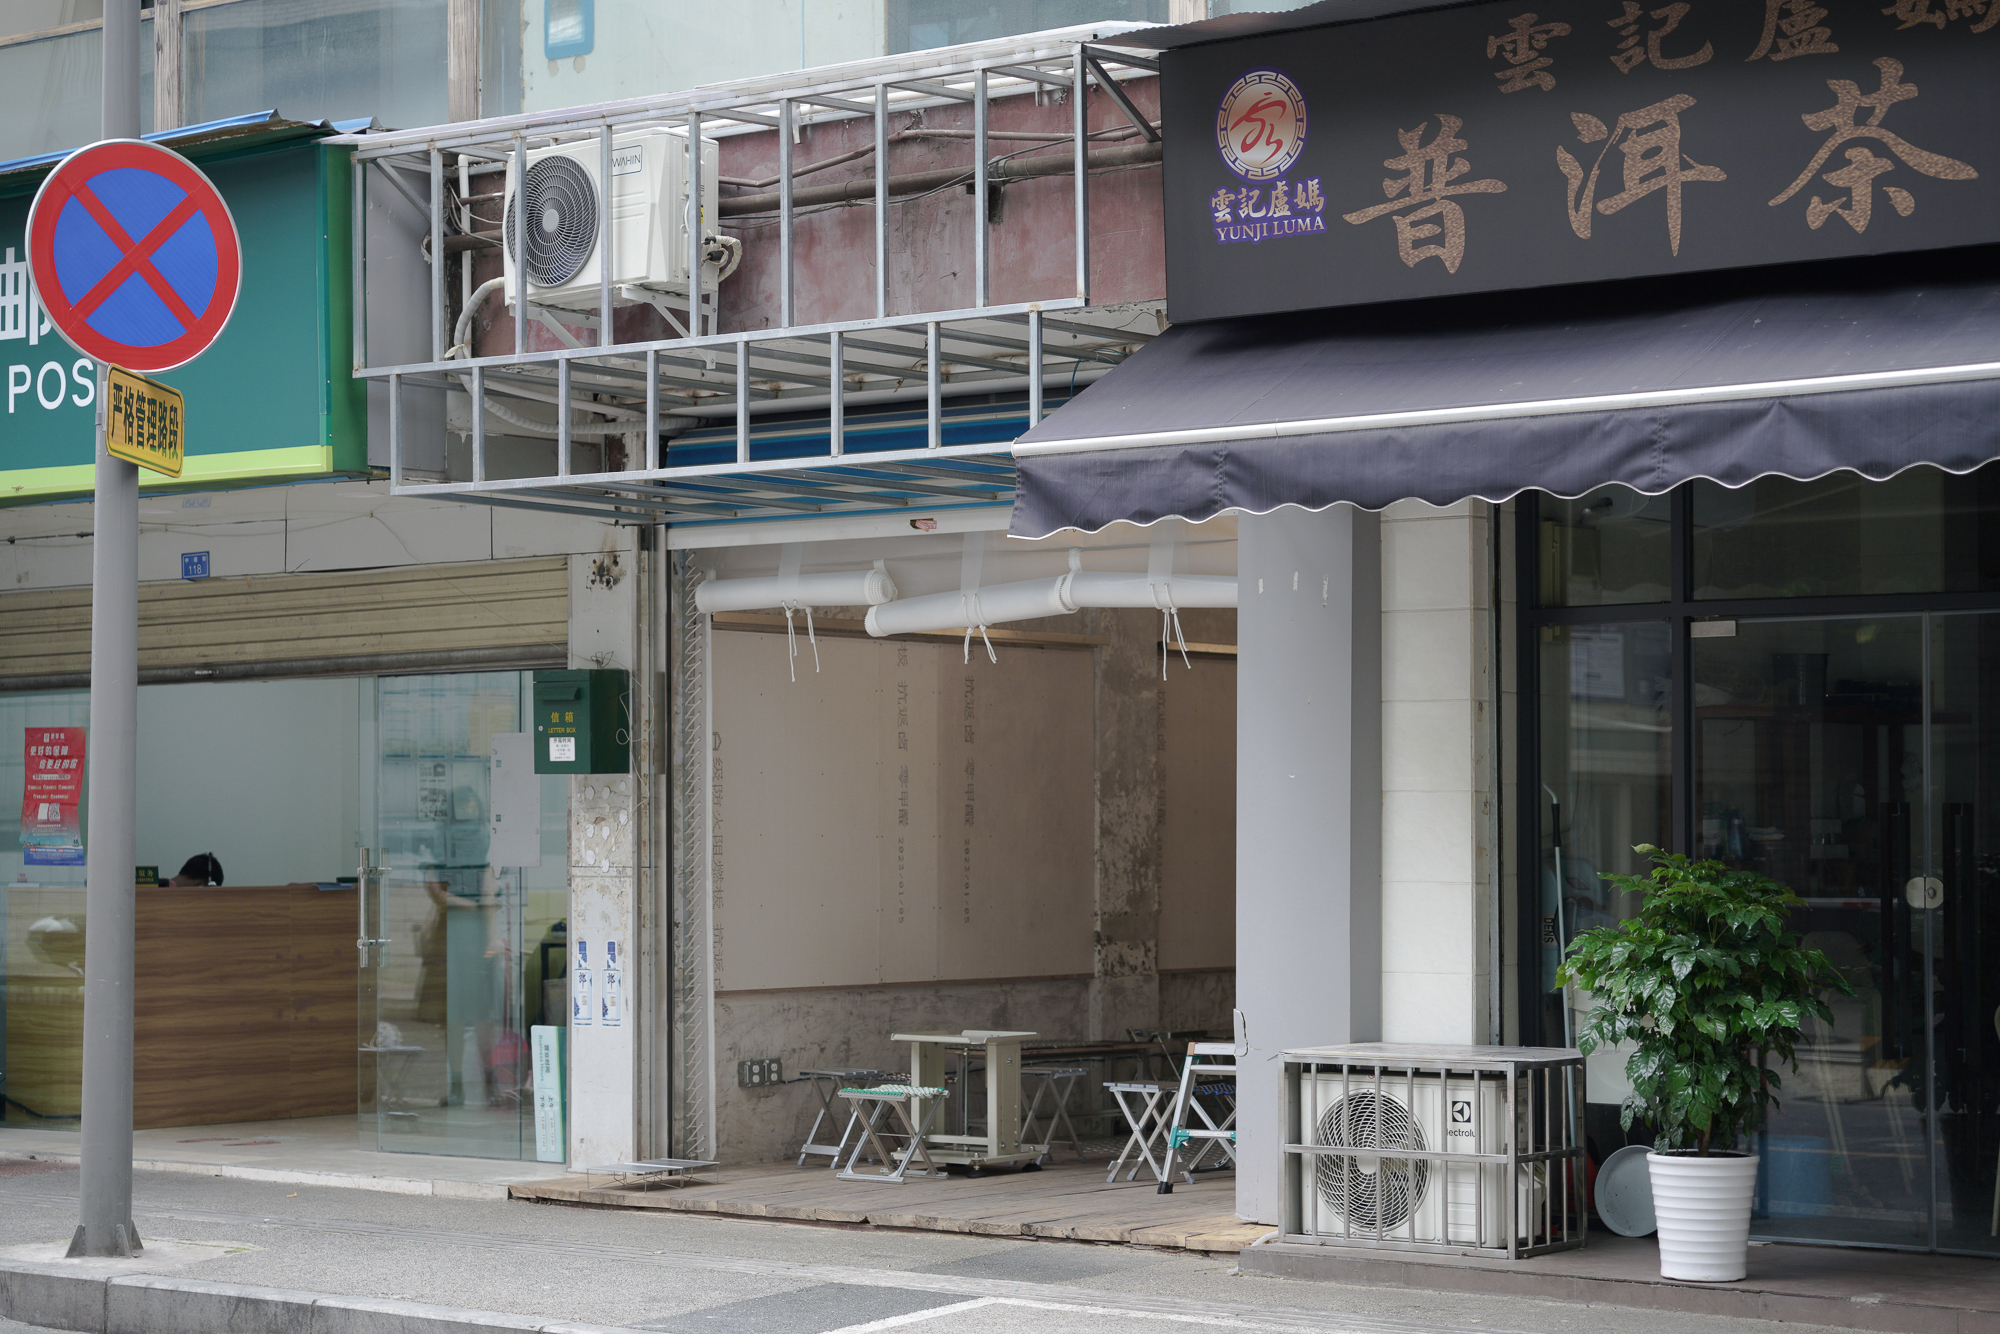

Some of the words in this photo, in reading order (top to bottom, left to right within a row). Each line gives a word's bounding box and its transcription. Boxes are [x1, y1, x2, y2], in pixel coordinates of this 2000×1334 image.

[1343, 57, 1979, 274] 普洱茶
[1211, 179, 1325, 223] 雲記盧媽
[1216, 221, 1268, 242] YUNJI
[1273, 216, 1325, 236] LUMA
[8, 358, 95, 414] POS
[111, 383, 179, 460] 严格管理路段
[188, 564, 202, 575] 118
[551, 711, 574, 723] 信箱
[135, 869, 154, 877] 服务
[1446, 1128, 1476, 1138] lectrolu
